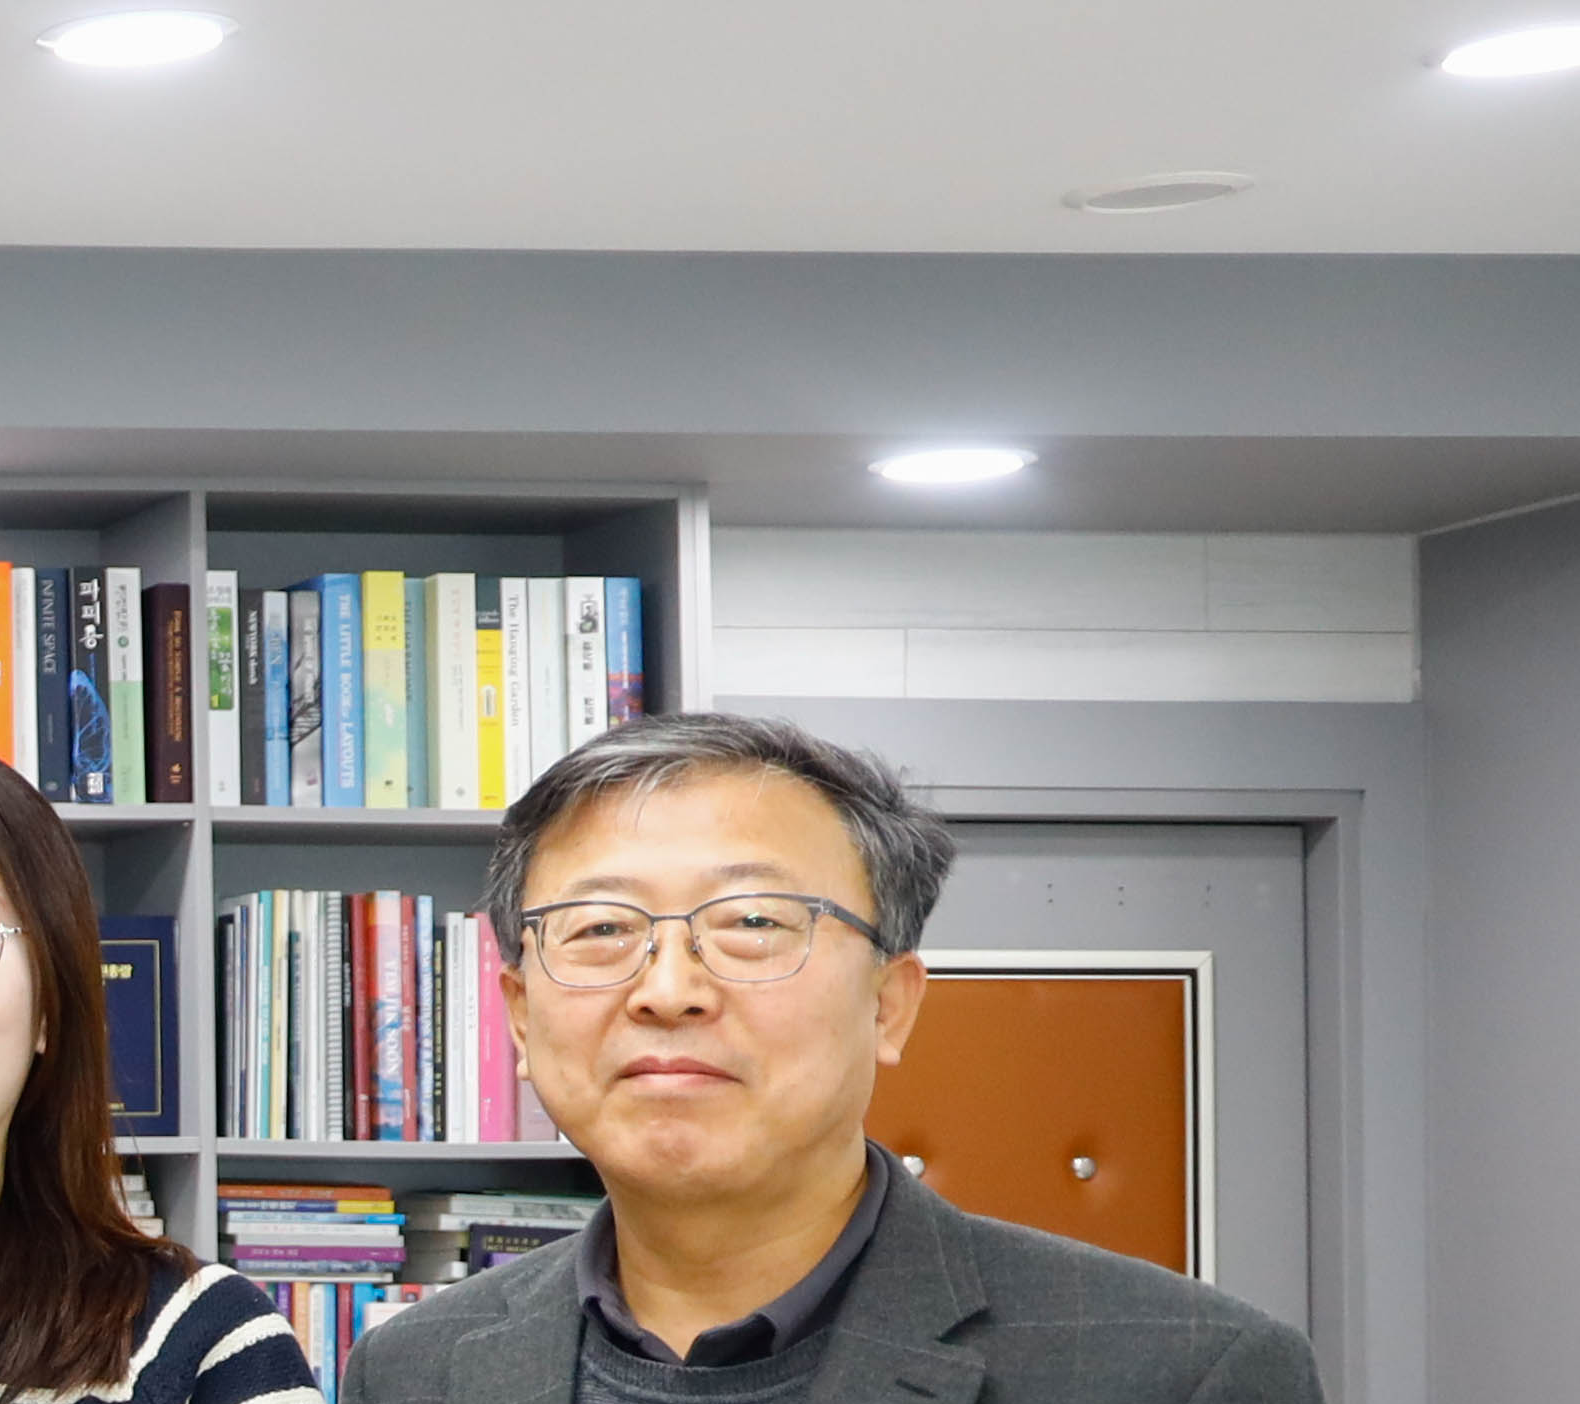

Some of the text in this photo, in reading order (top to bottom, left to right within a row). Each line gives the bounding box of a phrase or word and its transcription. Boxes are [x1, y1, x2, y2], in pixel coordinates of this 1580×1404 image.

[42, 579, 55, 673] INFINITE SPACE
[339, 595, 353, 618] THE
[339, 624, 353, 667] LITTLE
[339, 722, 353, 788] LAYOUTS
